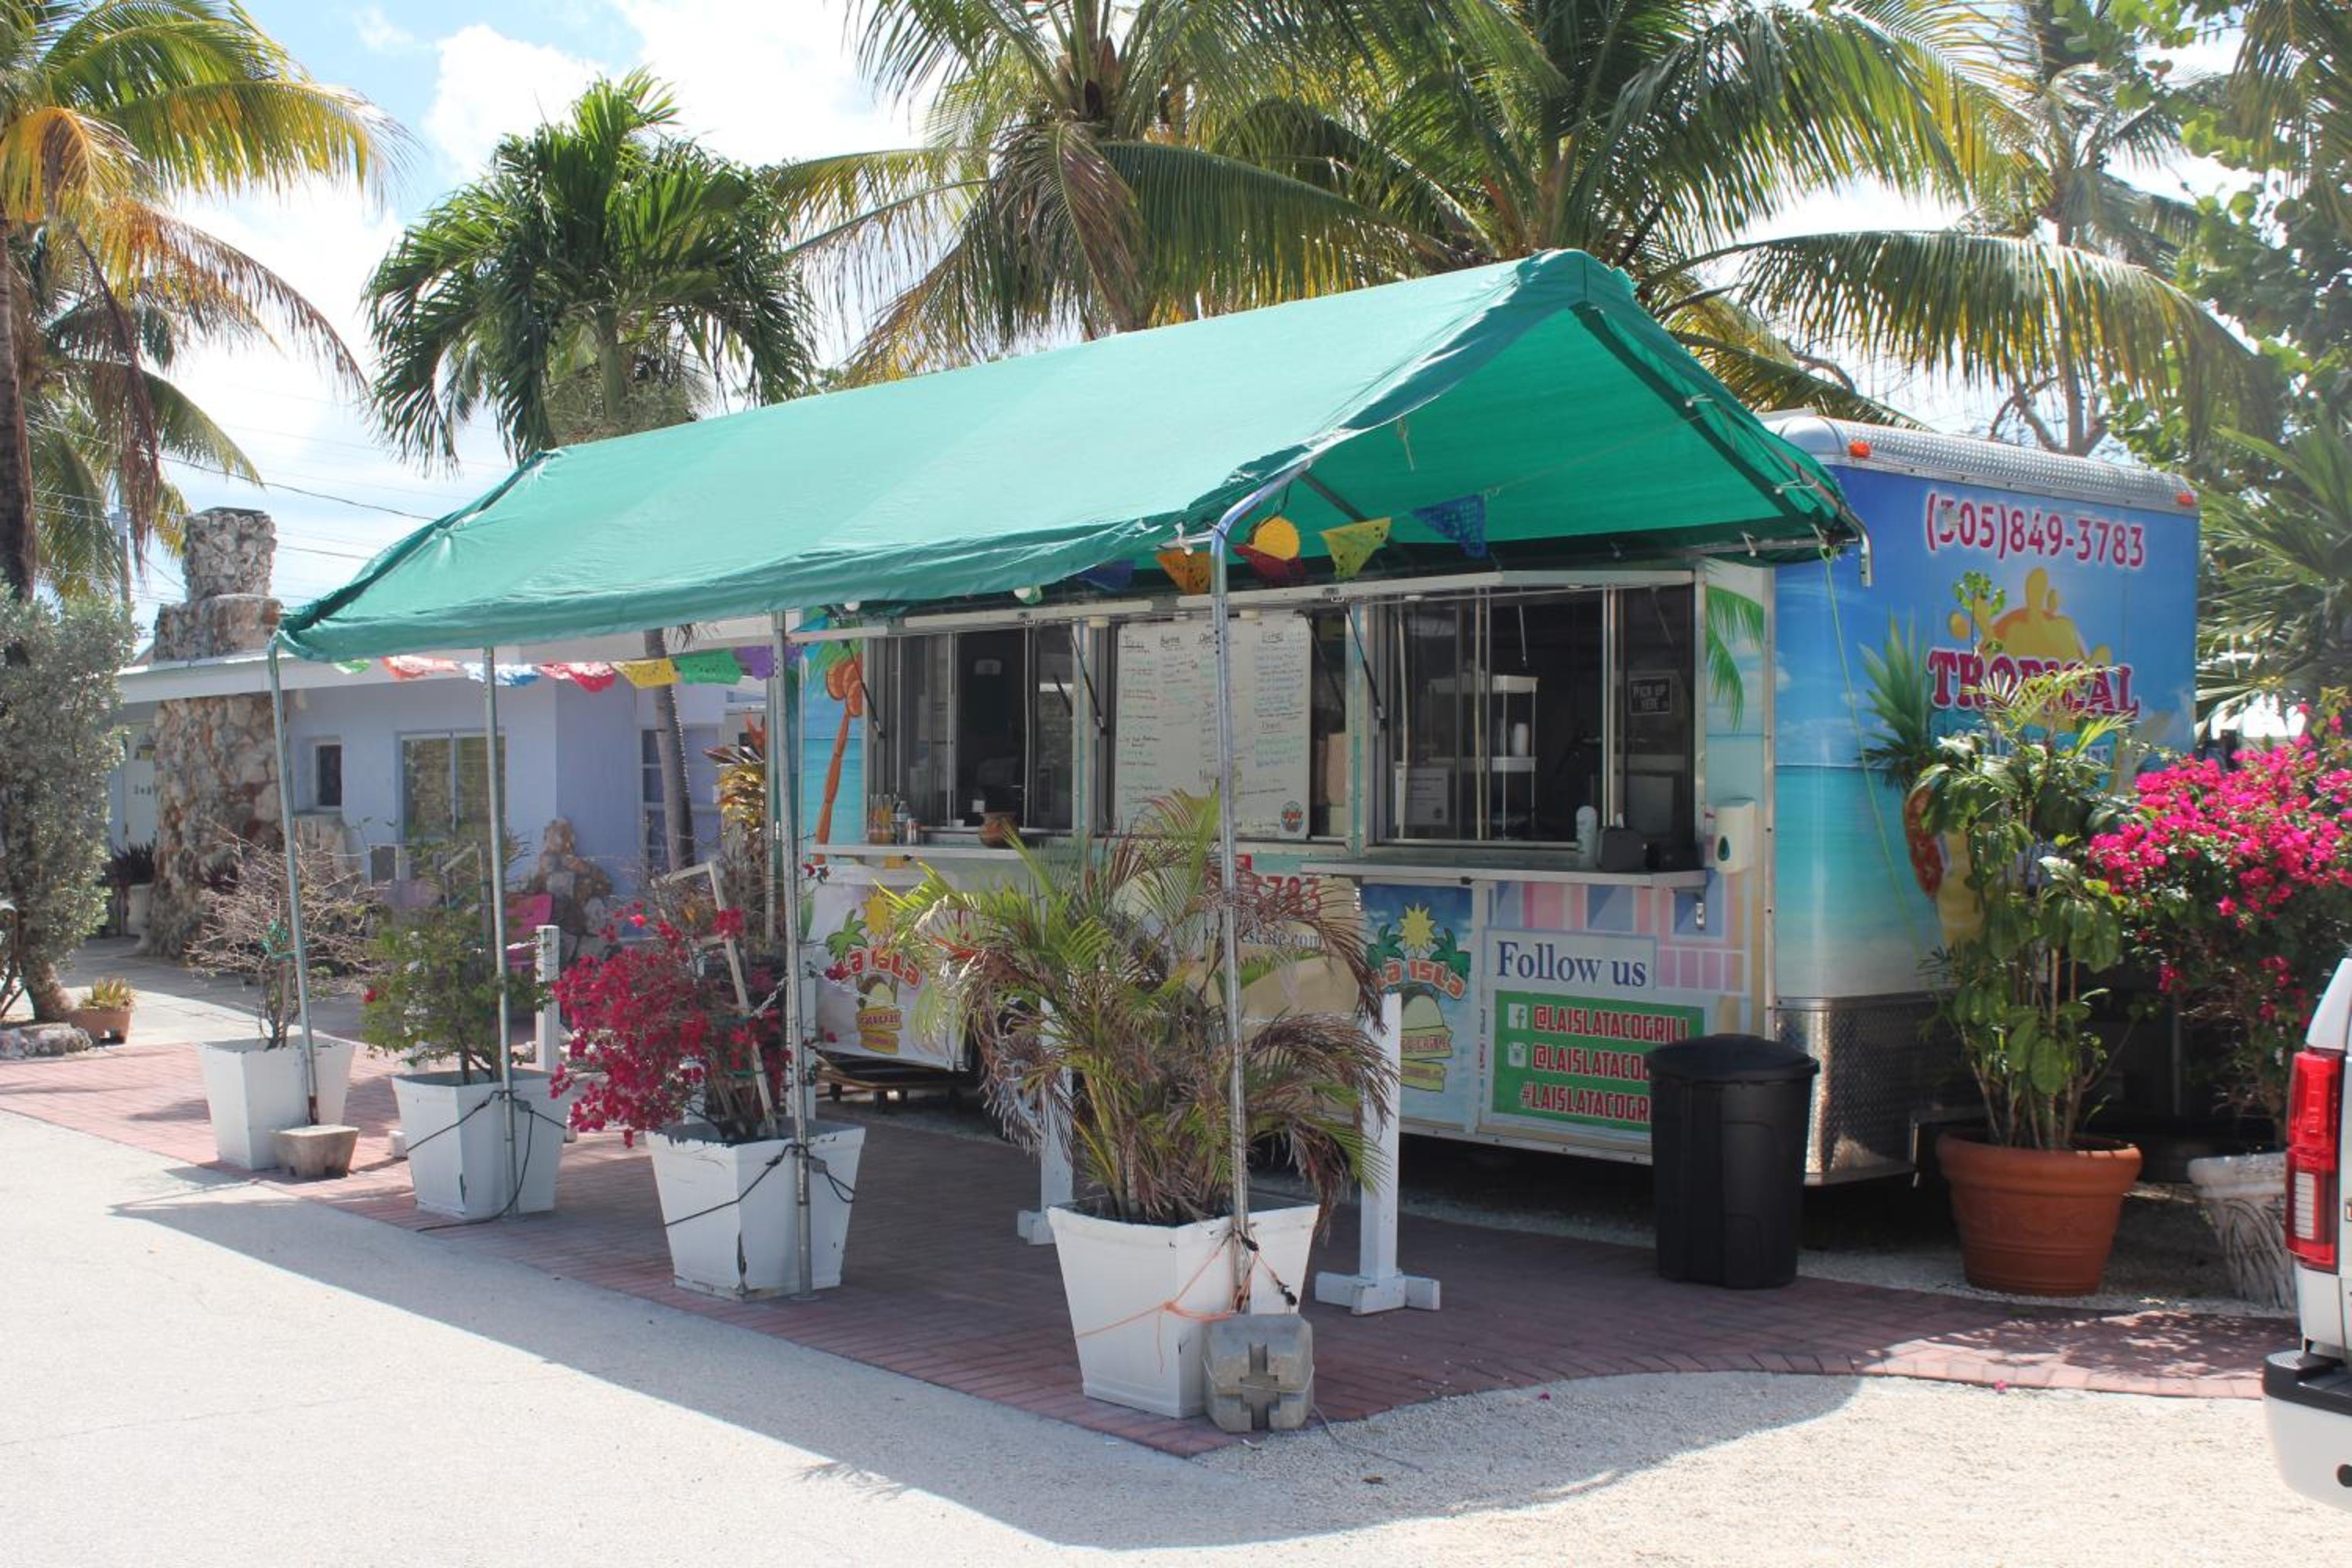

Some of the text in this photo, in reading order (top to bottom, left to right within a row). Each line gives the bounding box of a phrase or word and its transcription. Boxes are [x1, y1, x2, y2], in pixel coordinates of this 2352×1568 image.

[1926, 492, 2144, 568] (305)849-3783
[1497, 941, 1646, 987] Follow us
